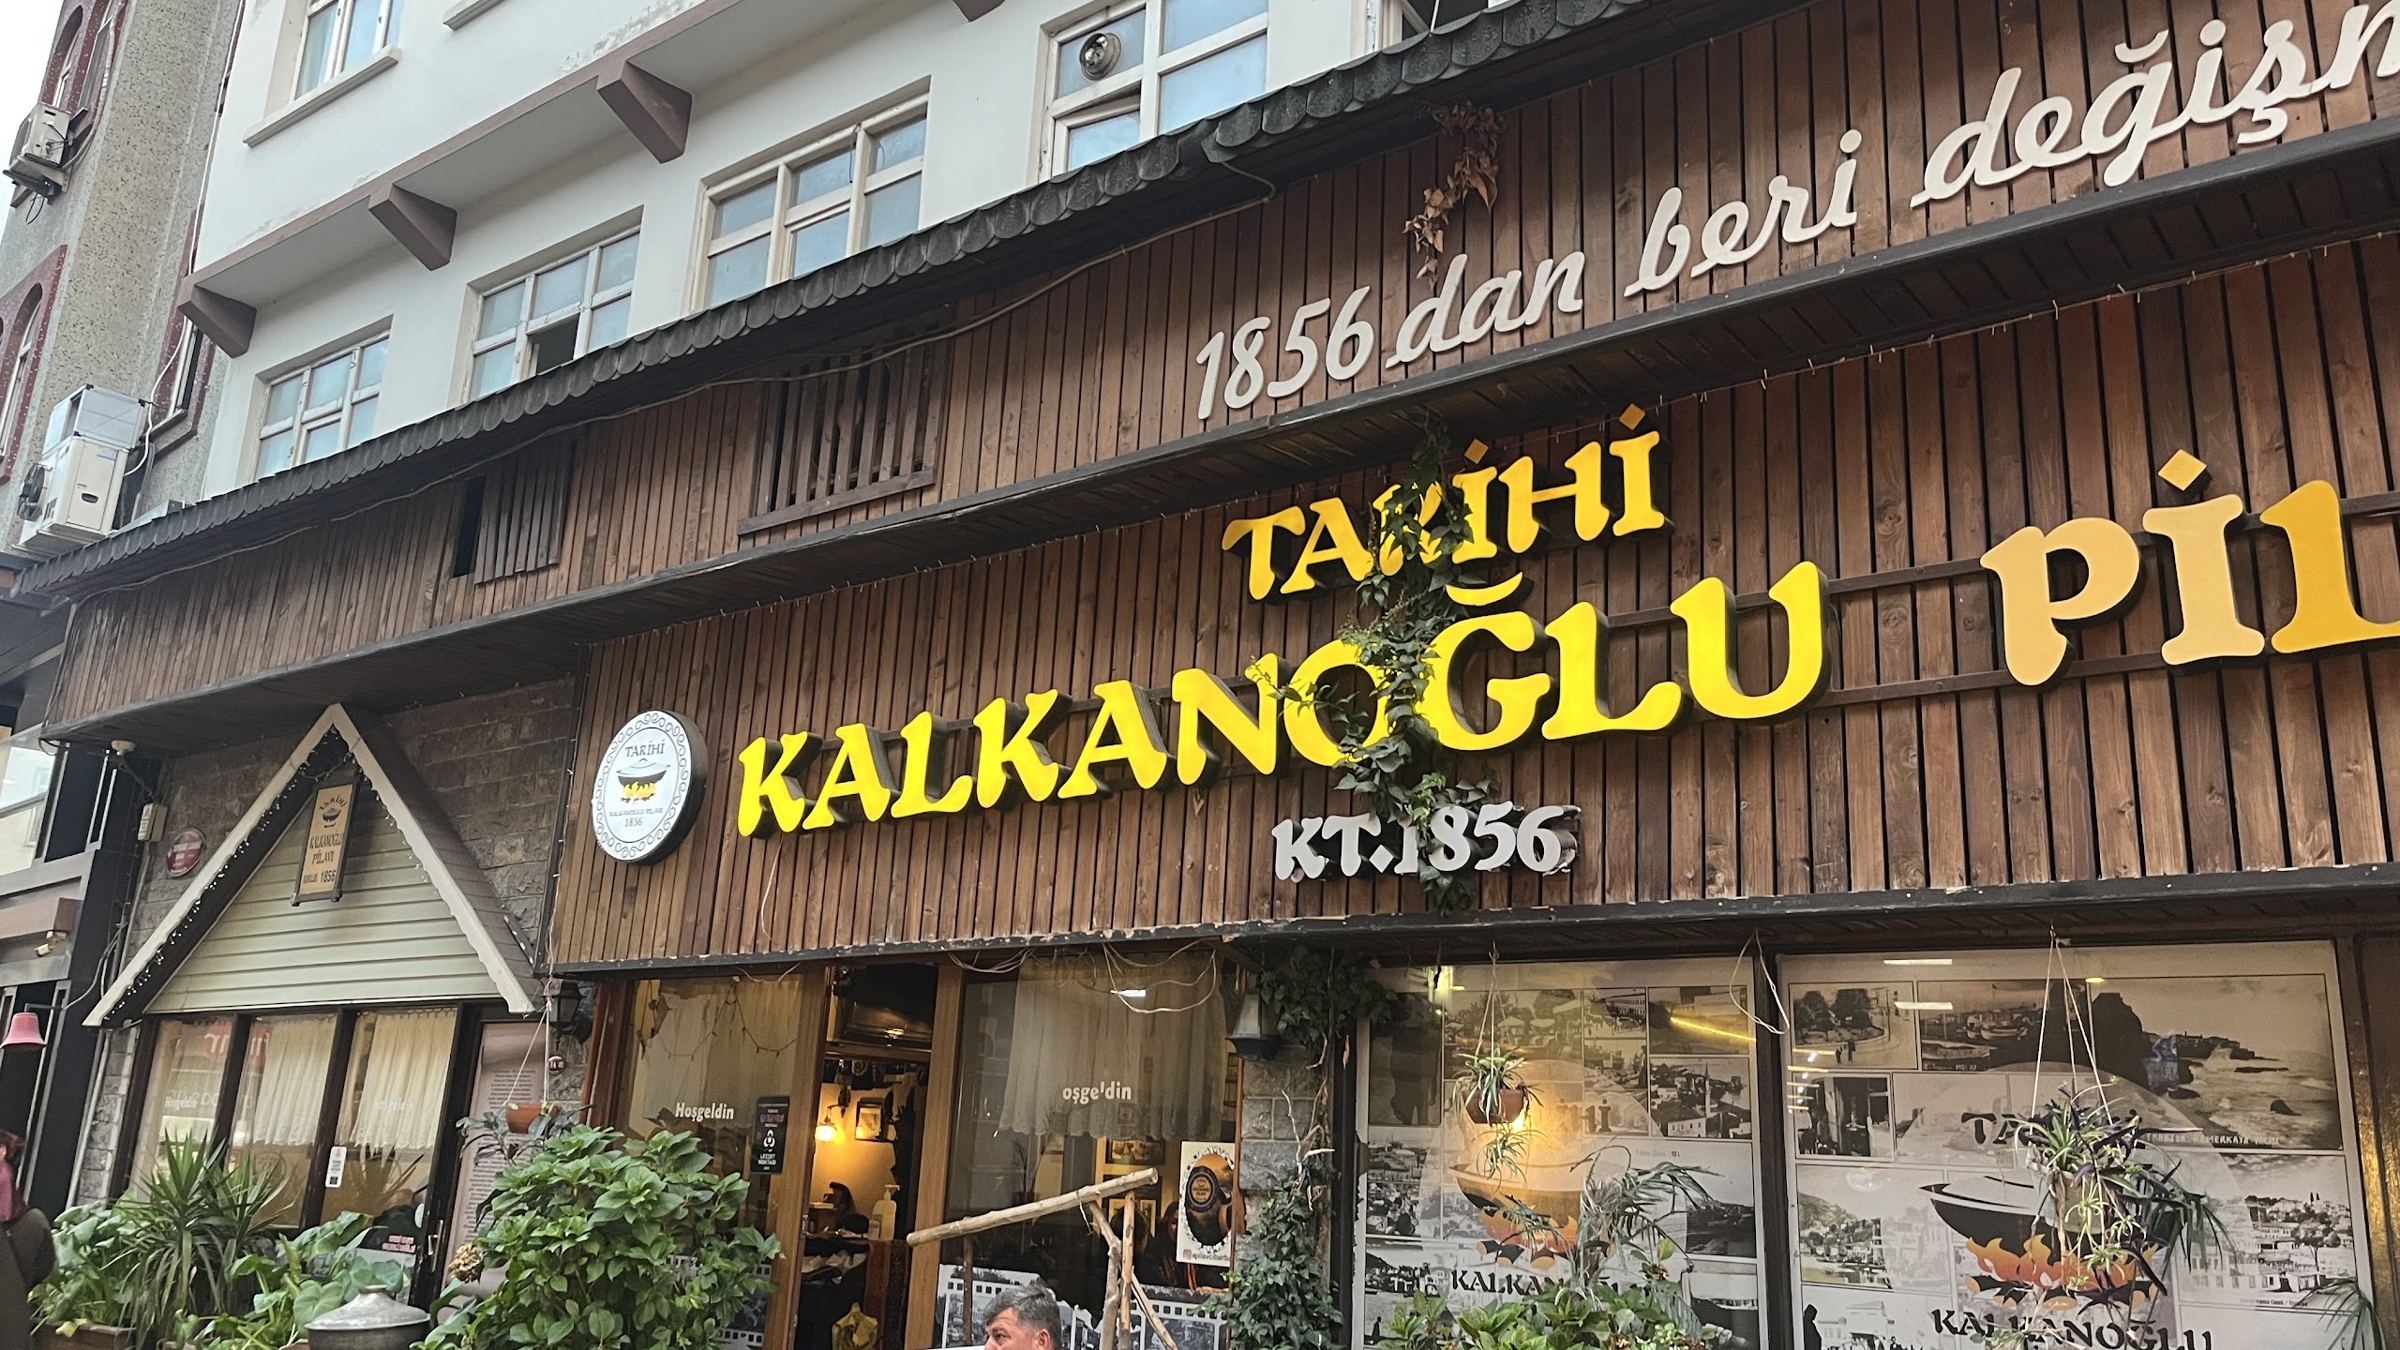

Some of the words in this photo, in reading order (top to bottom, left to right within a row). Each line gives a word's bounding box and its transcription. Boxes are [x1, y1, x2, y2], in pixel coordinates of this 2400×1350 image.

[1624, 129, 1857, 297] beri
[737, 560, 1823, 837] KALKANOĞLU
[625, 739, 666, 757] TARİHİ
[674, 1102, 735, 1123] Hoşgeldin
